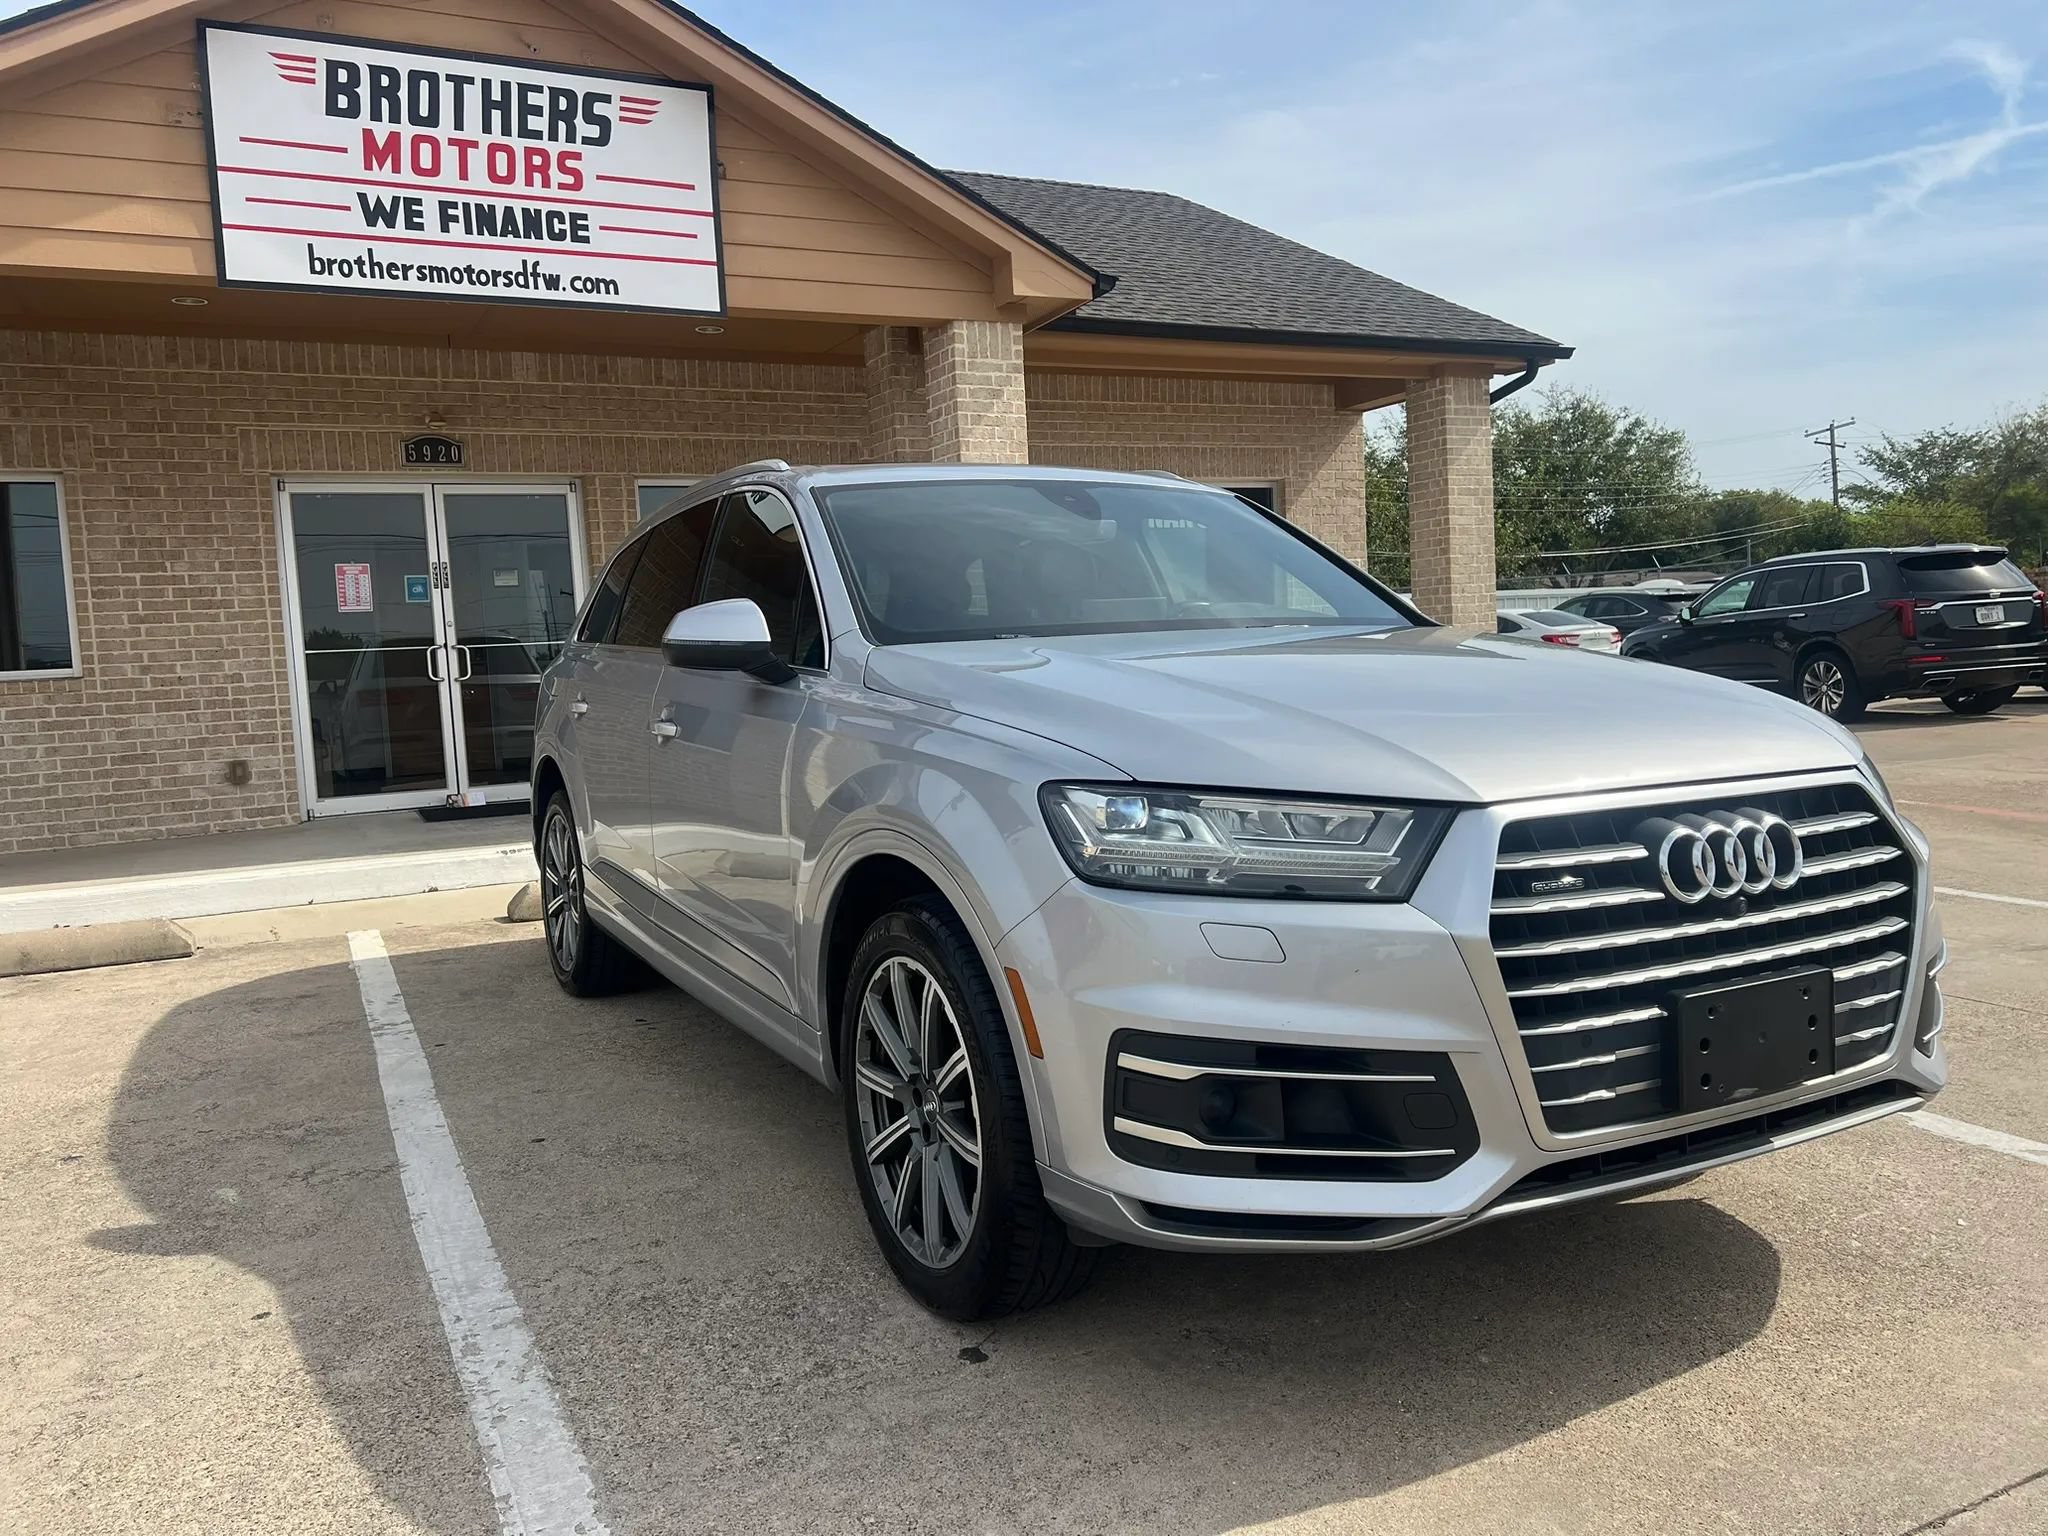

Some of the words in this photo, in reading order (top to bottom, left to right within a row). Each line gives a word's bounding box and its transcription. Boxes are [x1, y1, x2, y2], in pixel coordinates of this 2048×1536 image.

[324, 58, 613, 148] BROTHERS
[362, 128, 584, 192] MOTORS
[356, 191, 425, 232] WE
[438, 200, 591, 245] FINANCE
[307, 243, 620, 296] brothersmotorsdfw.com
[408, 444, 459, 462] 5920
